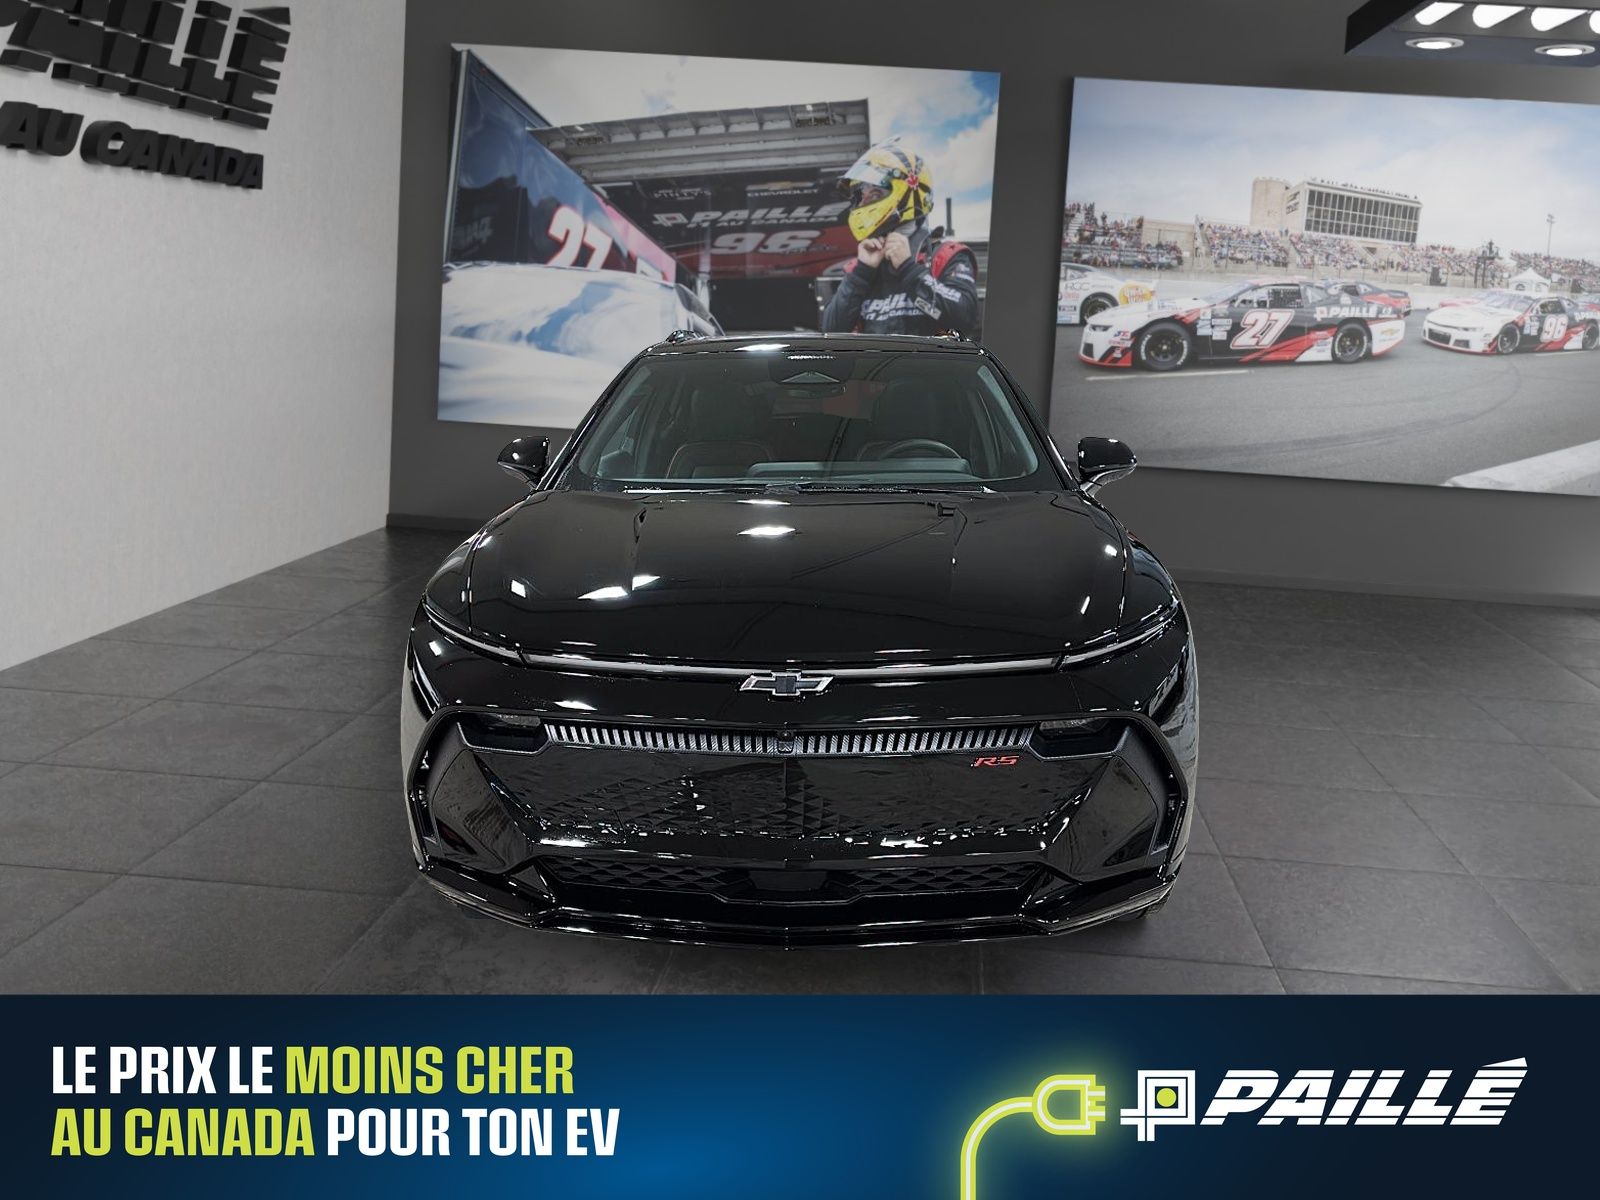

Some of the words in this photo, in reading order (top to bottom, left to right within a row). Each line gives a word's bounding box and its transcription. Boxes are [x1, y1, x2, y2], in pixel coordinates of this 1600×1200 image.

[80, 120, 264, 190] CANADA
[747, 189, 818, 198] CHEVROLET
[547, 205, 614, 272] 27
[709, 230, 821, 255] 96
[1229, 308, 1296, 350] 27
[1540, 313, 1569, 343] 96
[973, 755, 1020, 767] RS
